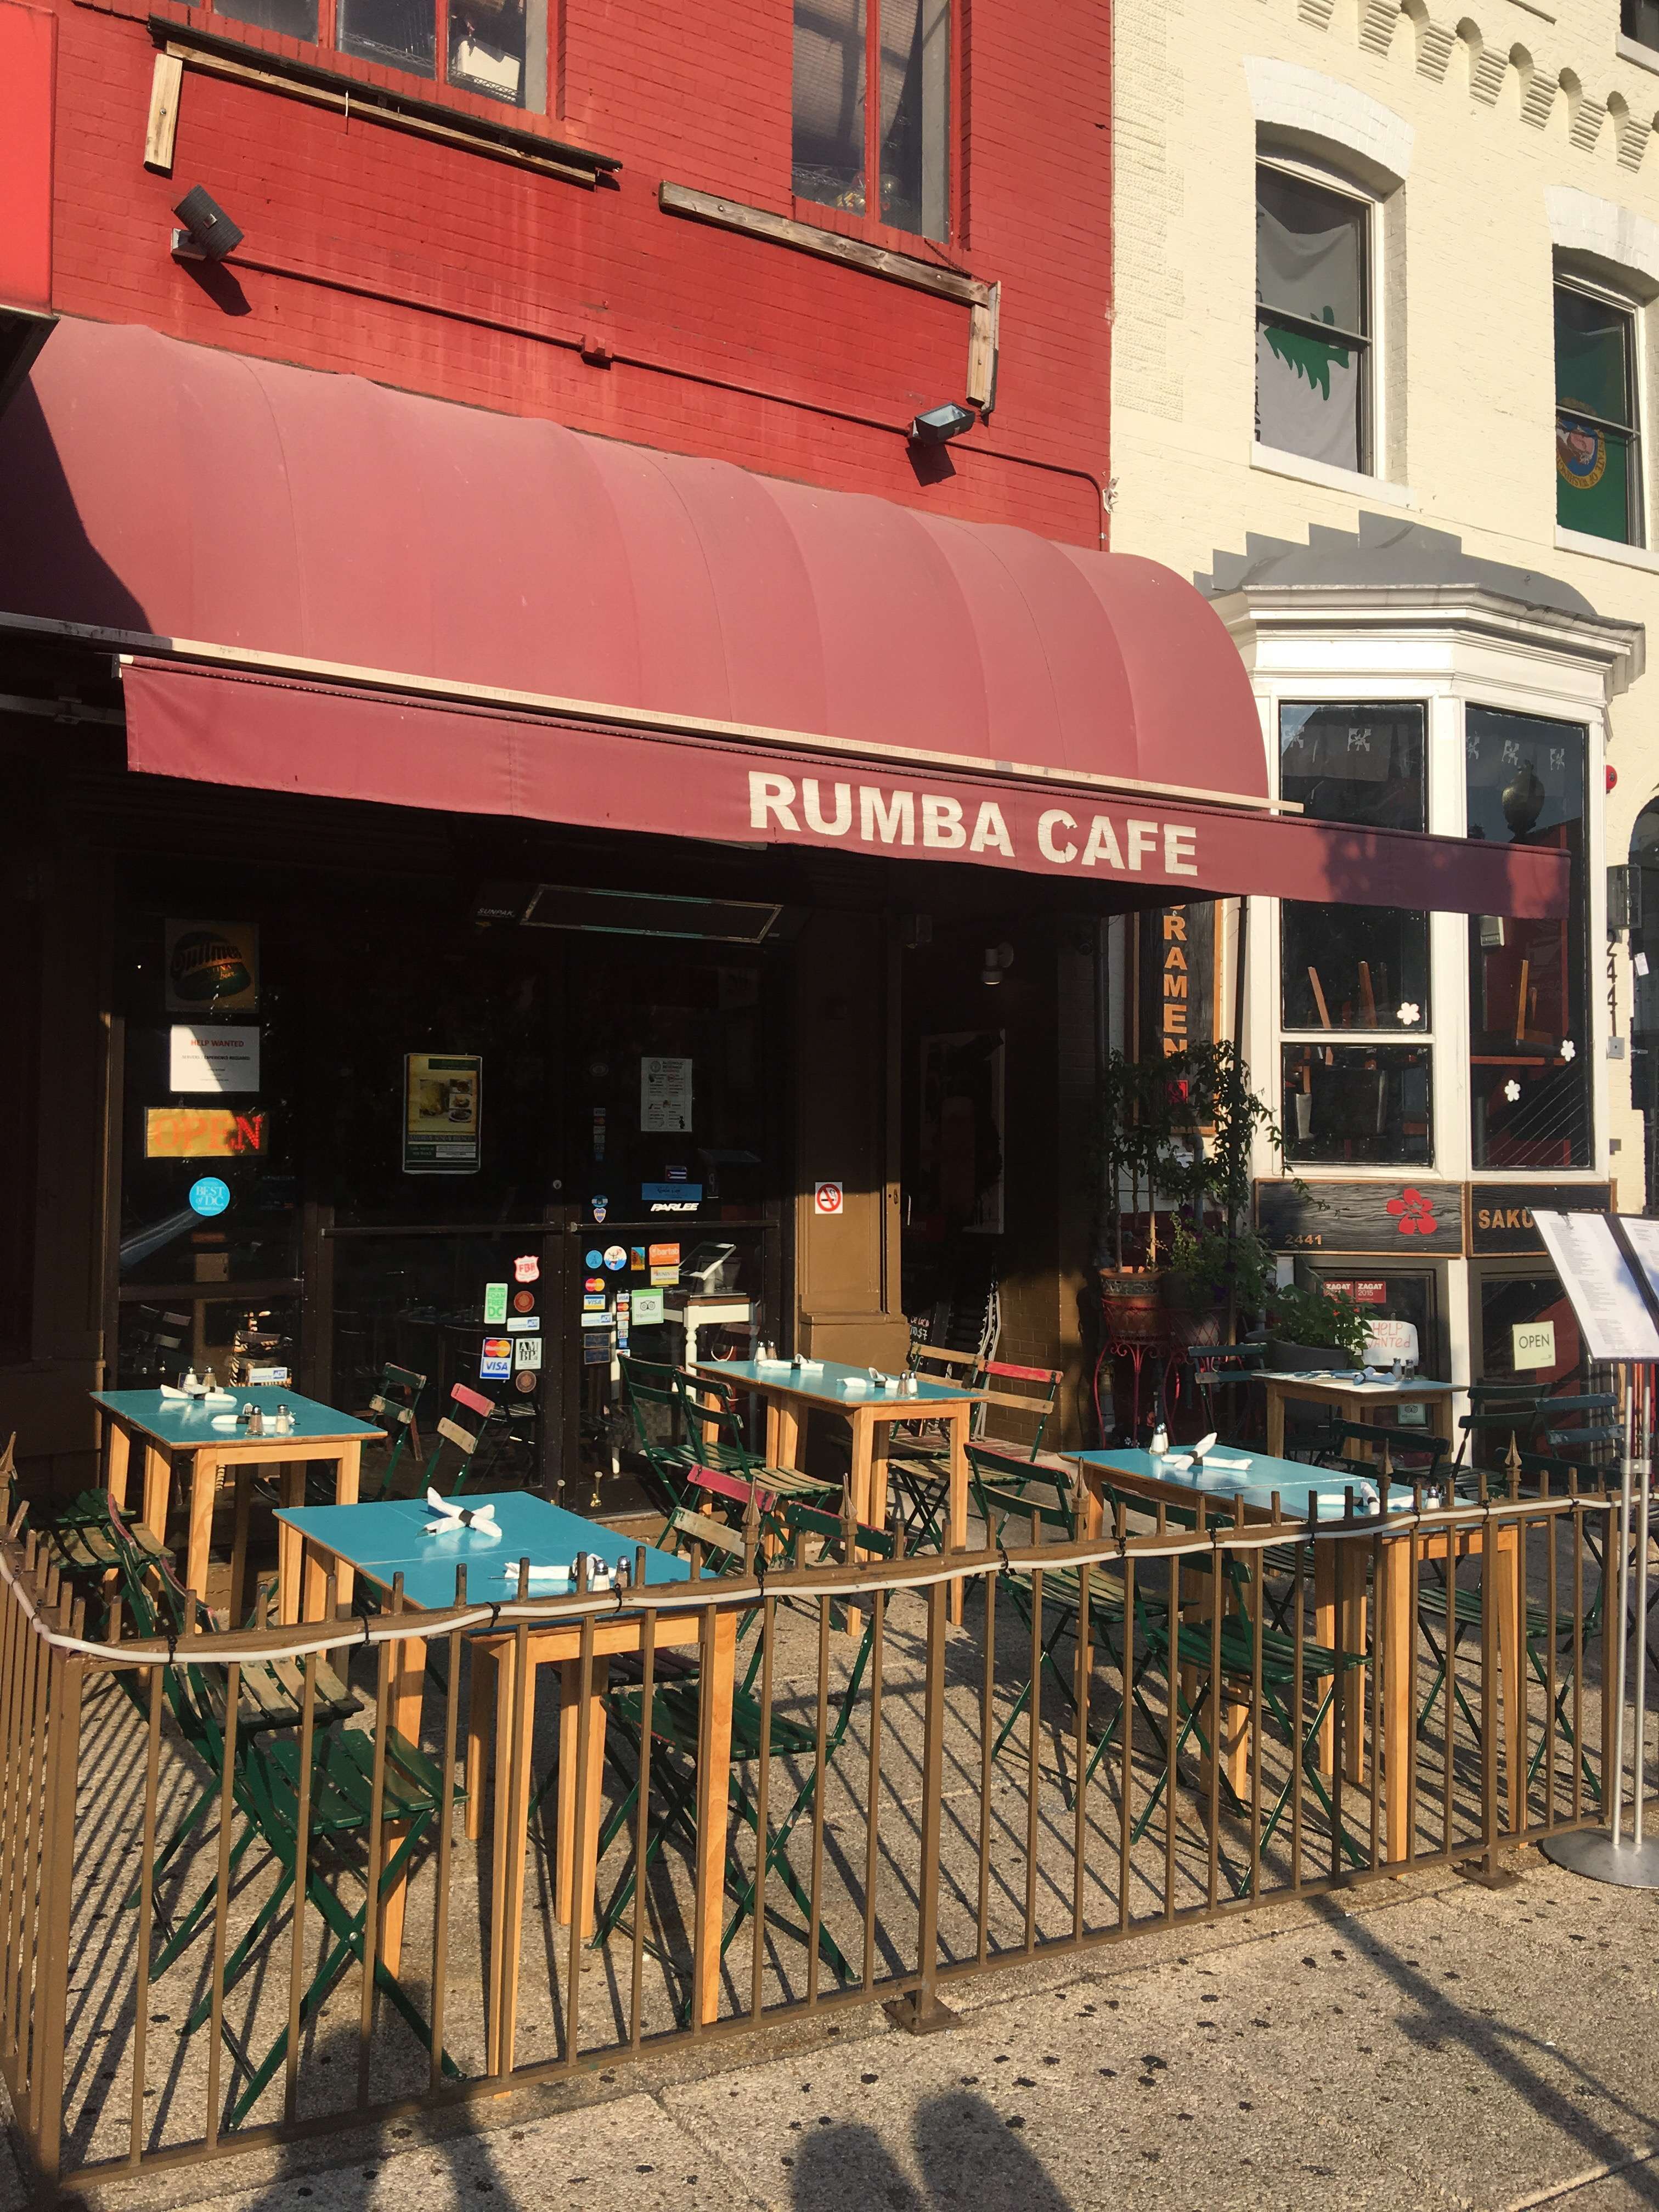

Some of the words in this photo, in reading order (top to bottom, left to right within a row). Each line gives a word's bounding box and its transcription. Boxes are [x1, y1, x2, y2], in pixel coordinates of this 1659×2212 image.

[748, 771, 1015, 857] RUMBA
[1038, 808, 1198, 876] CAFE
[1164, 905, 1188, 1058] RAMEN
[155, 1115, 263, 1150] OPEN
[196, 1186, 224, 1195] BEST
[650, 1203, 699, 1211] PARLEE
[1285, 1234, 1322, 1245] 2441
[488, 1307, 504, 1317] DC
[1519, 1334, 1550, 1348] OPEN
[486, 1360, 508, 1371] VISA
